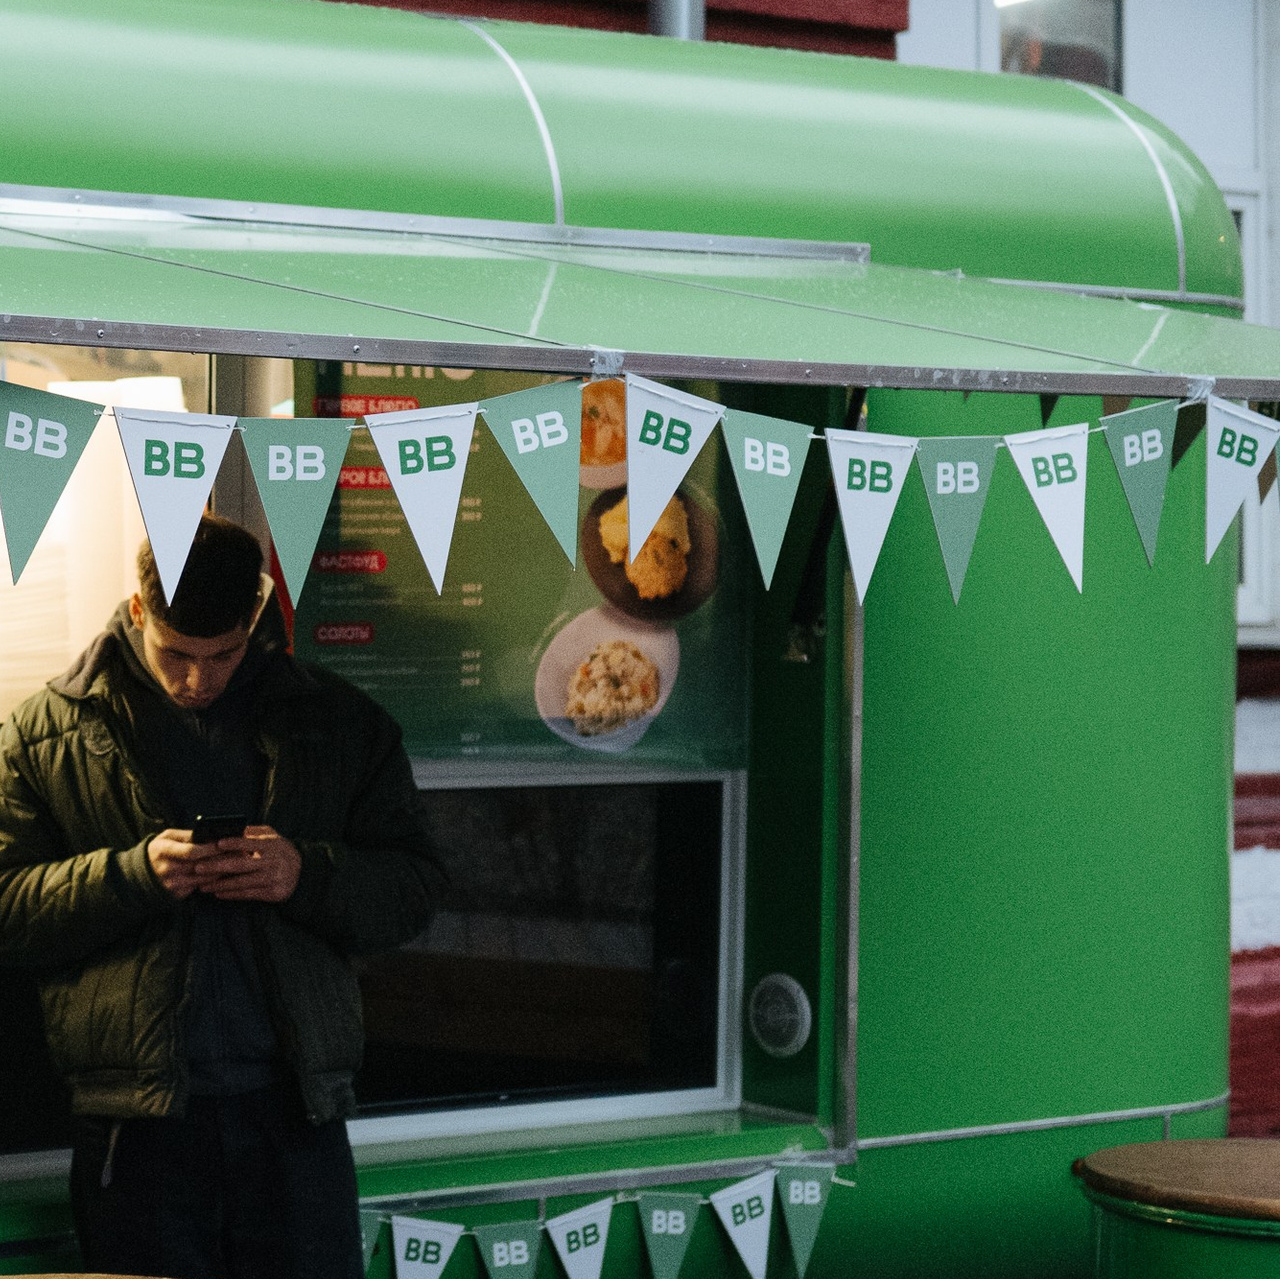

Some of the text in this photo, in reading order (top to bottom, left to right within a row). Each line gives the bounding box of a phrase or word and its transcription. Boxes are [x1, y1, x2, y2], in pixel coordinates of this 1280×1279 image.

[4, 410, 69, 460] ВВ
[510, 410, 569, 455] ВВ
[638, 409, 693, 456] ВВ
[1122, 427, 1164, 469] ВВ
[1216, 426, 1259, 468] ВВ
[143, 439, 206, 480] ВВ
[268, 444, 327, 482] ВВ
[398, 435, 457, 476] ВВ
[743, 437, 792, 478] ВВ
[1031, 452, 1078, 489] ВВ
[846, 457, 894, 494] ВВ
[936, 461, 980, 495] ВВ
[731, 1195, 766, 1227] ВВ
[789, 1179, 821, 1206] ВВ
[565, 1223, 601, 1254] ВВ
[650, 1209, 686, 1236] ВВ
[404, 1237, 442, 1265] ВВ
[492, 1239, 530, 1268] ВВ
